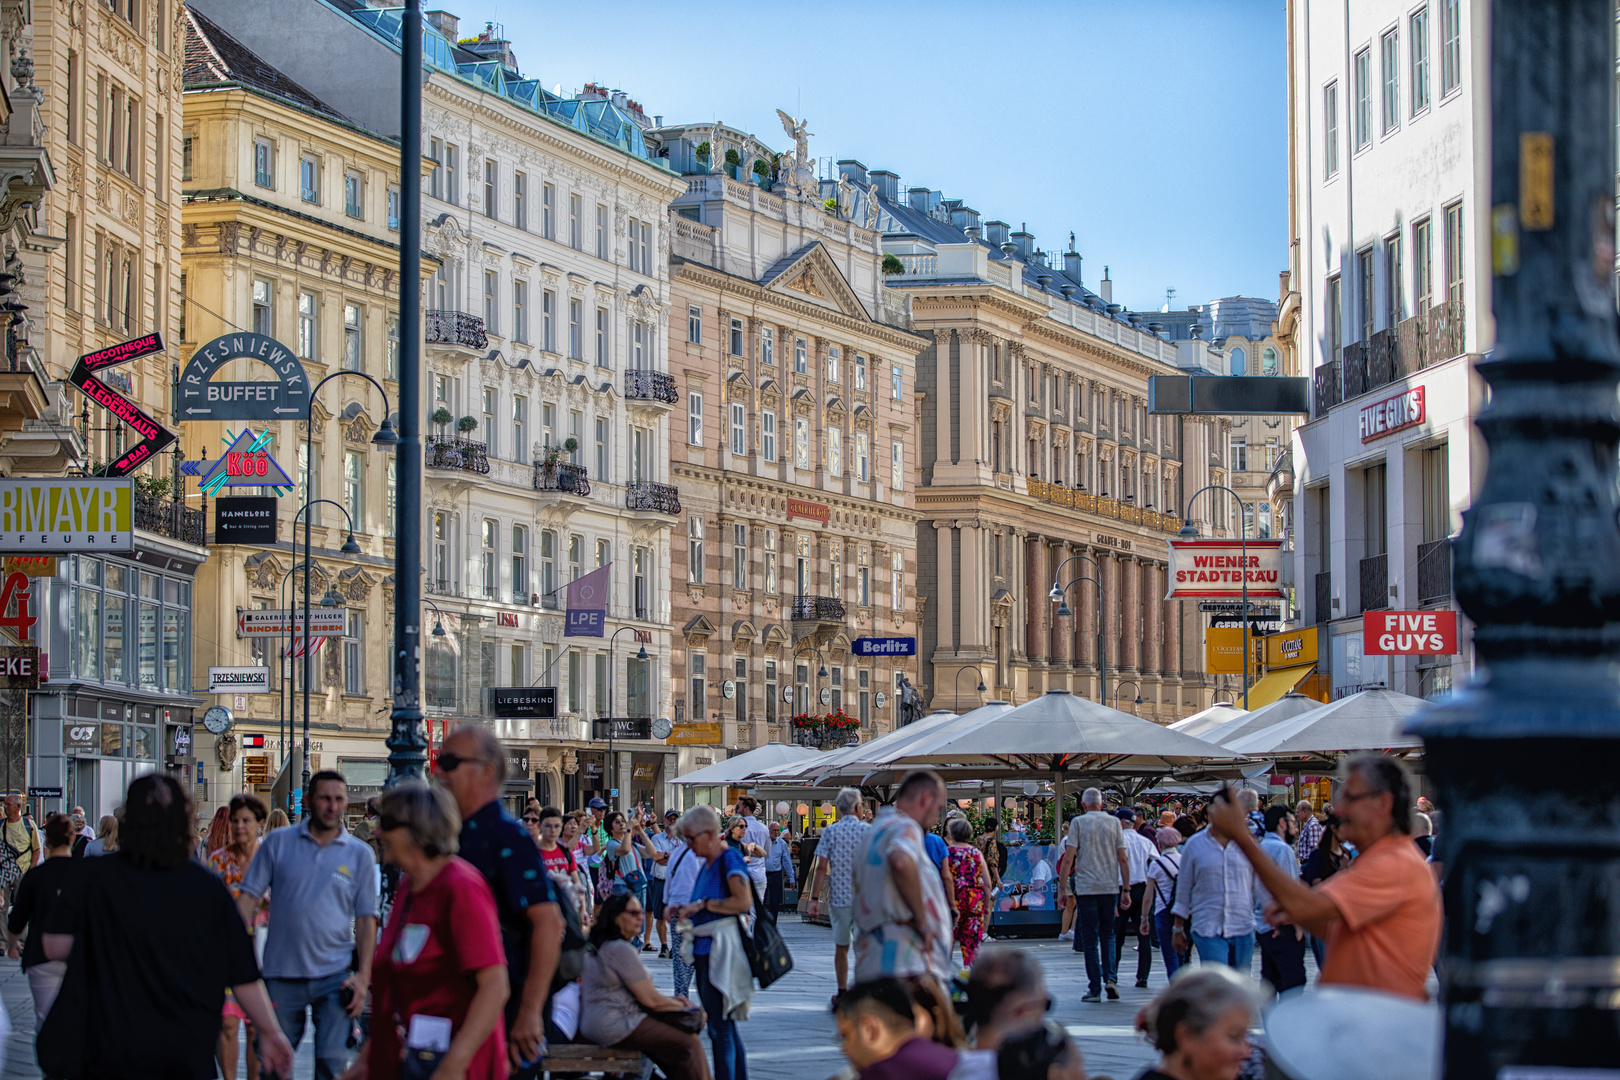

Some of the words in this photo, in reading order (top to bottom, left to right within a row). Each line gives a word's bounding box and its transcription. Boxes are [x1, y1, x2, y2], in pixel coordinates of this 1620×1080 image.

[84, 335, 156, 365] DISCOTHEQUE
[207, 386, 279, 401] BUFFET
[81, 379, 158, 440] FLEDERMAUS
[111, 393, 137, 414] CABARET
[1359, 403, 1387, 438] FIVE
[1386, 390, 1421, 429] GUYS
[127, 444, 148, 462] BAR
[1193, 556, 1260, 568] WIENER
[1176, 570, 1278, 582] STADTBRÄU
[497, 612, 519, 628] LISKA
[570, 612, 598, 625] LPE
[1385, 615, 1437, 631] FIVE
[634, 630, 652, 644] LISKA
[1379, 634, 1444, 651] GUYS
[863, 640, 908, 653] Berlitz
